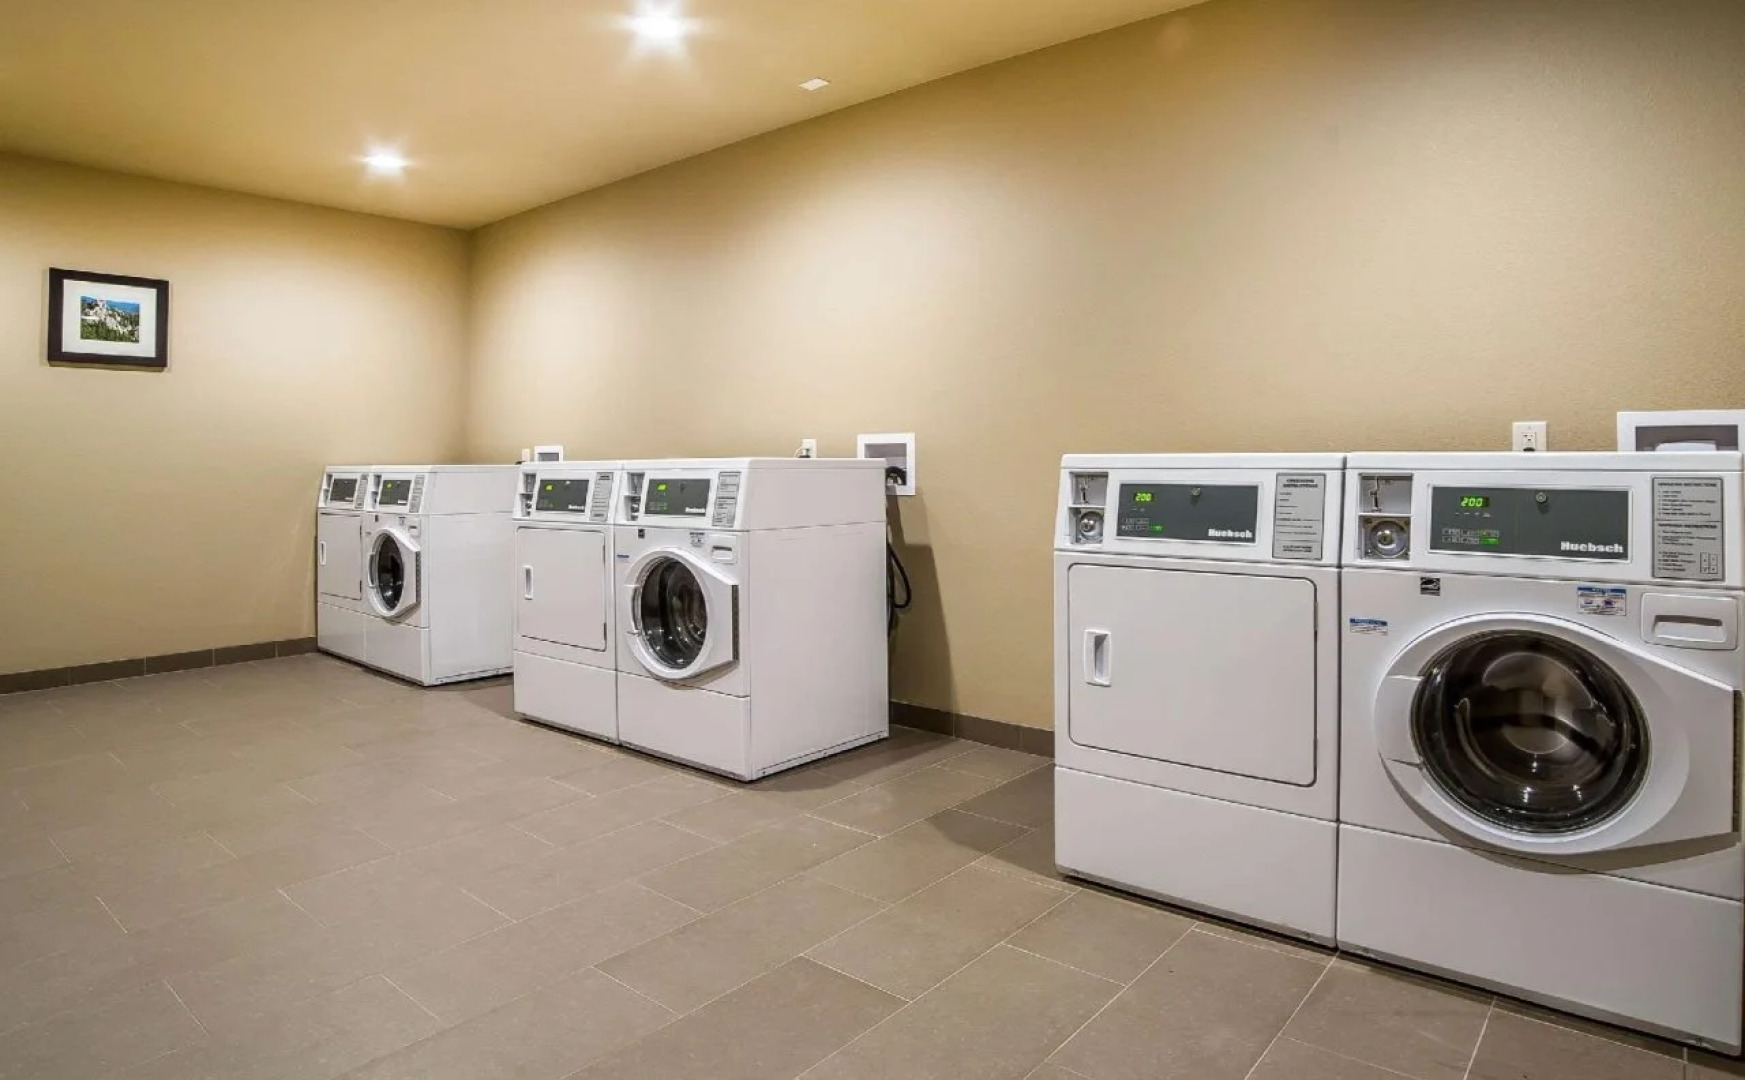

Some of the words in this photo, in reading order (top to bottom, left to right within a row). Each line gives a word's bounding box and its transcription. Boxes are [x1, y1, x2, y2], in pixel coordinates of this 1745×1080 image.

[1461, 497, 1483, 507] 200
[1208, 528, 1253, 538] Huebsch
[1560, 540, 1624, 553] Huebsch
